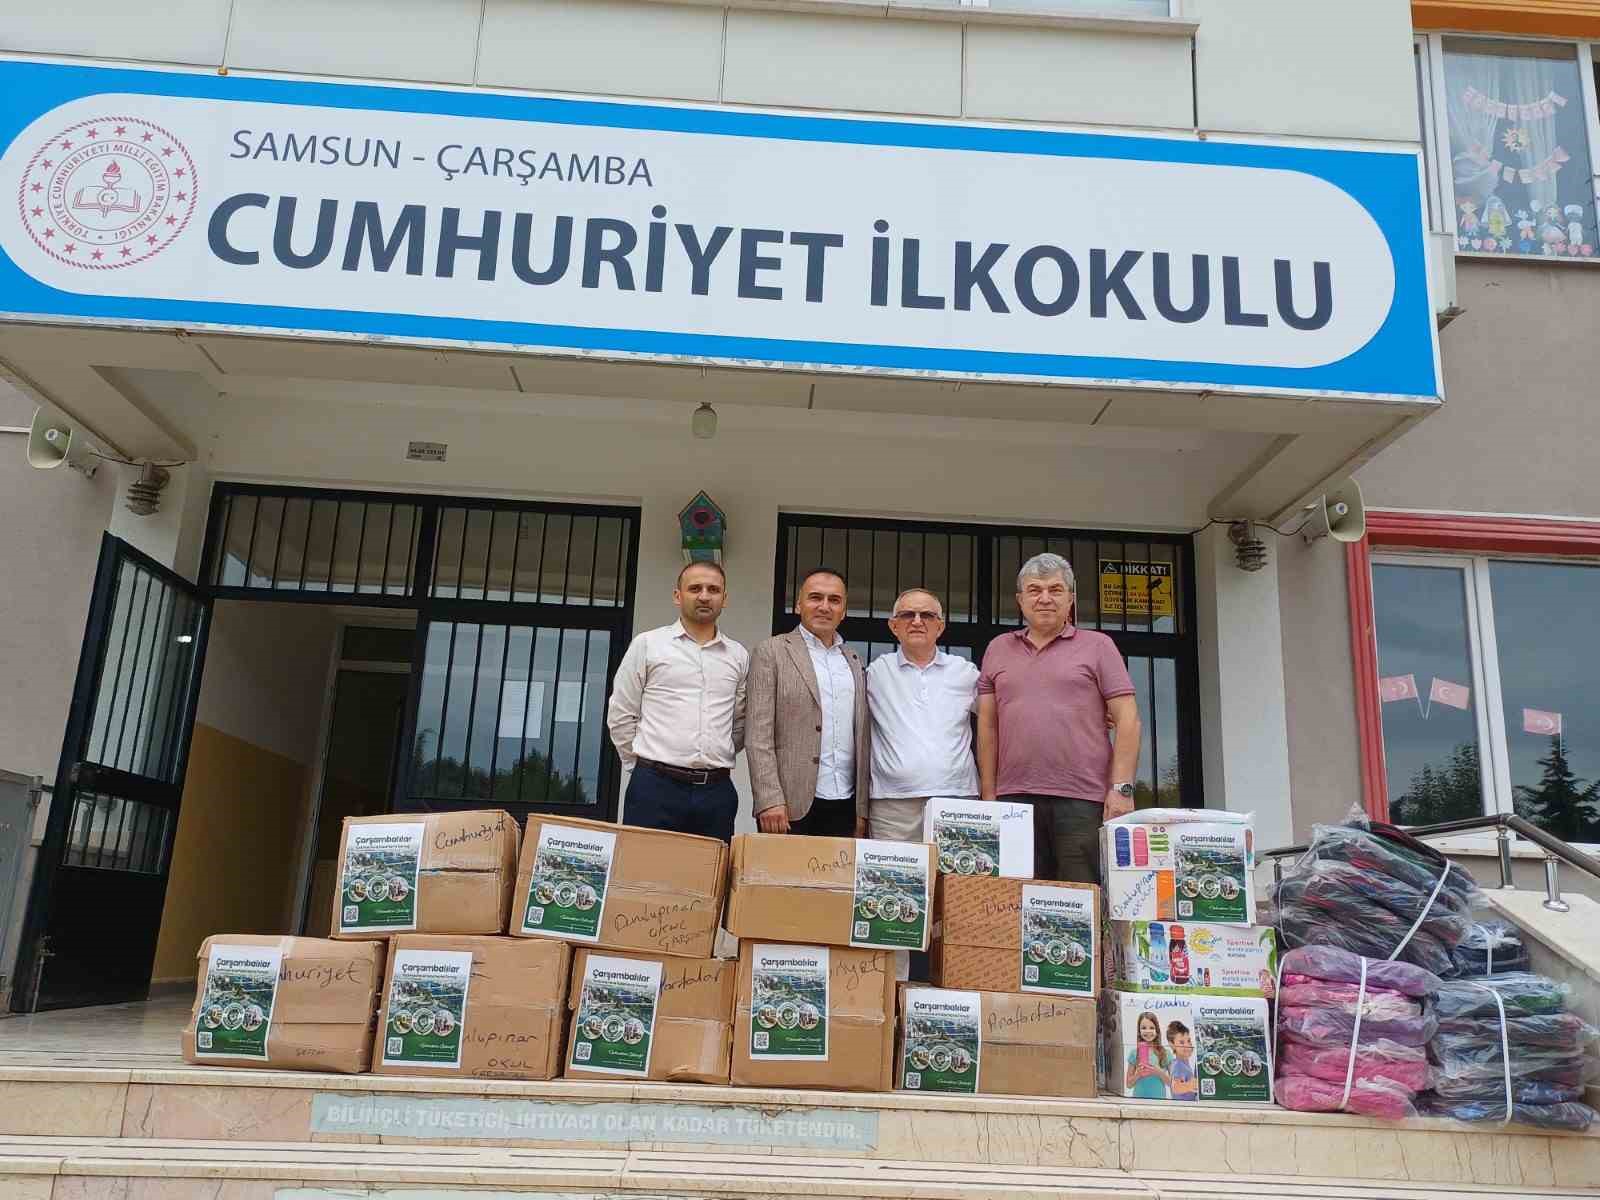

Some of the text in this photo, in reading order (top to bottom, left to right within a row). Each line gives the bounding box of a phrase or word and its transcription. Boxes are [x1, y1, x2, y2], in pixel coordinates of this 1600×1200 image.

[230, 130, 400, 169] SAMSUN
[436, 144, 653, 187] ÇARŞAMBA
[207, 192, 1333, 331] CUMHURİYET İLKOKULU
[607, 1114, 655, 1131] OLAN
[664, 1115, 729, 1134] KADAR
